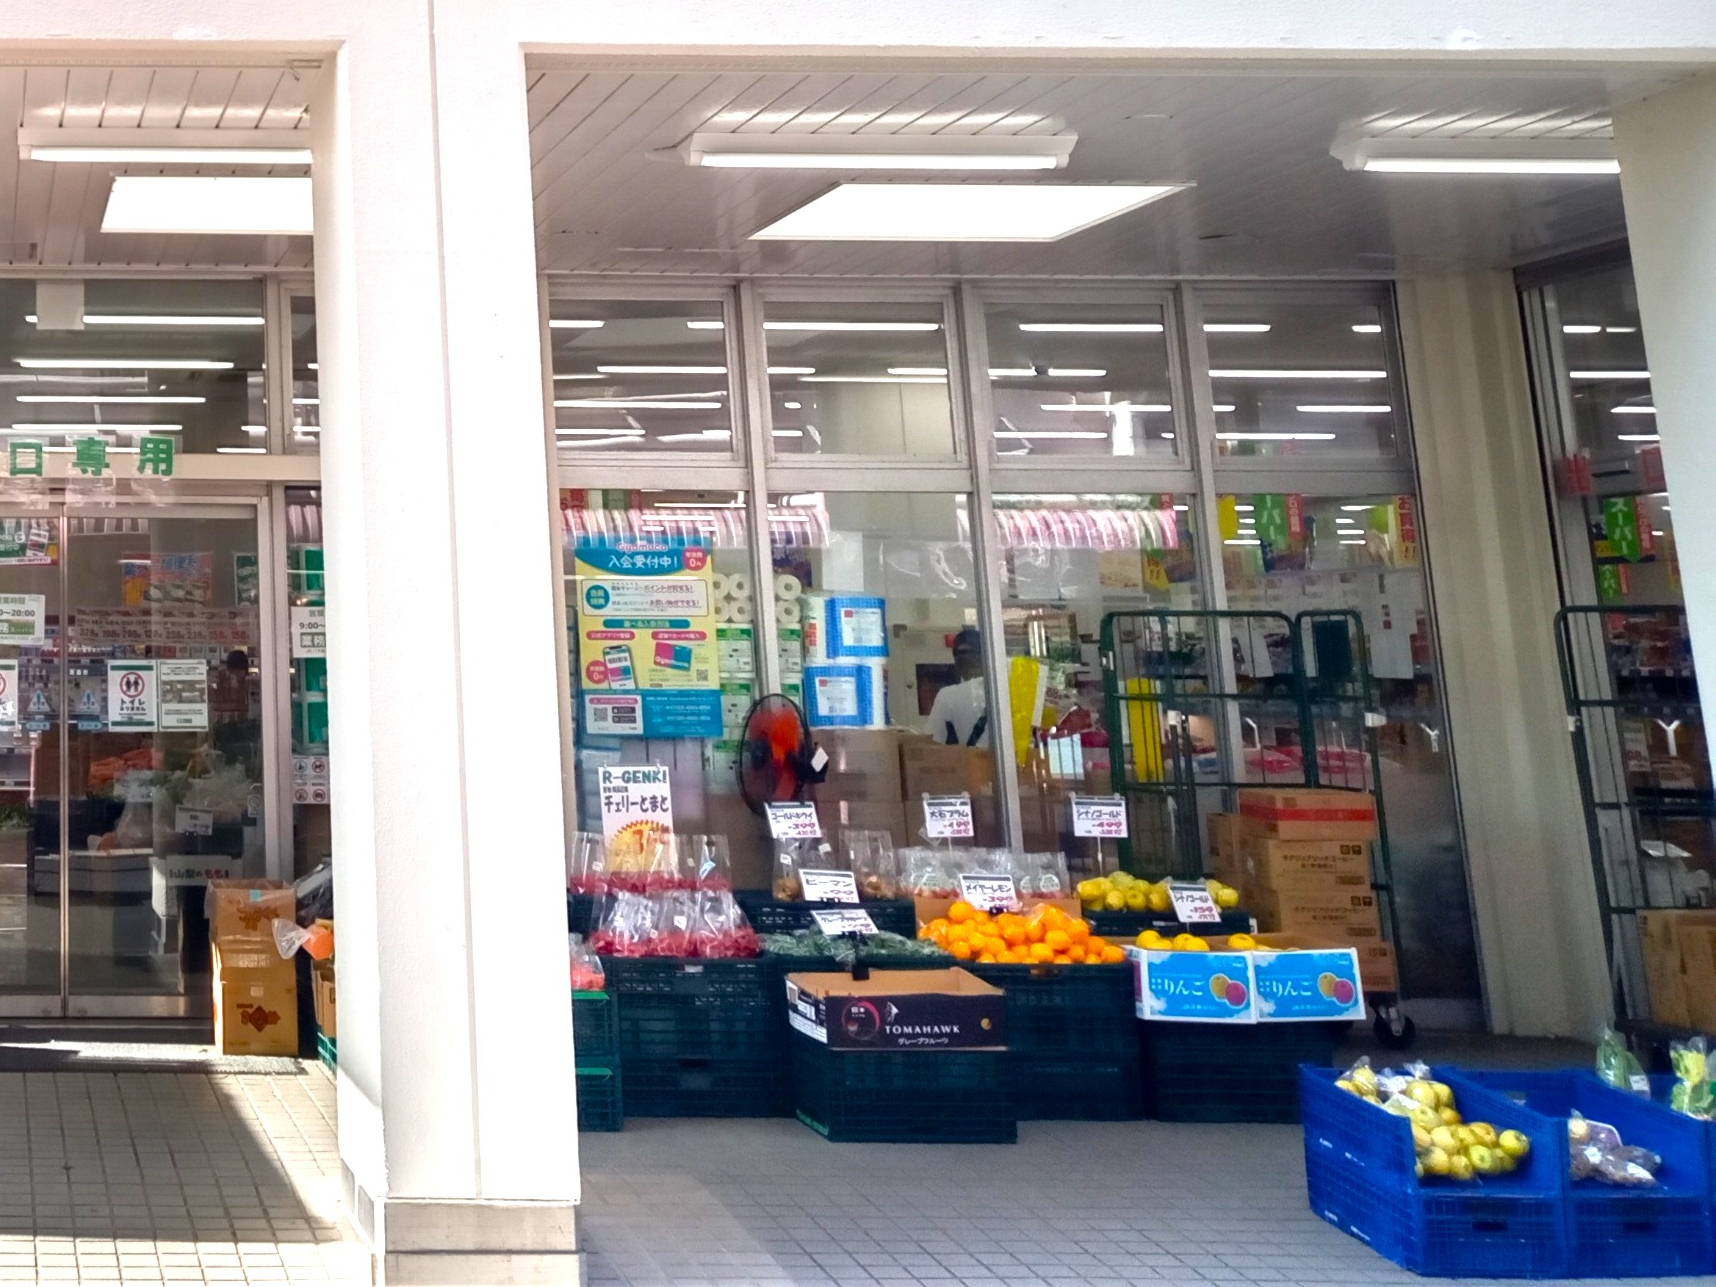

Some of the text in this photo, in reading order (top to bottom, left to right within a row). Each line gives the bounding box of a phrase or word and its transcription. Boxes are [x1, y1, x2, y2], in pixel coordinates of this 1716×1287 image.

[608, 554, 678, 569] 入会受付中!
[120, 698, 146, 707] トイレ
[604, 794, 670, 814] チェリーとまと
[965, 883, 1012, 893] メイヤーレモン
[884, 1025, 961, 1035] TOMAHAWK
[897, 1037, 949, 1046] グレープフルーツ
